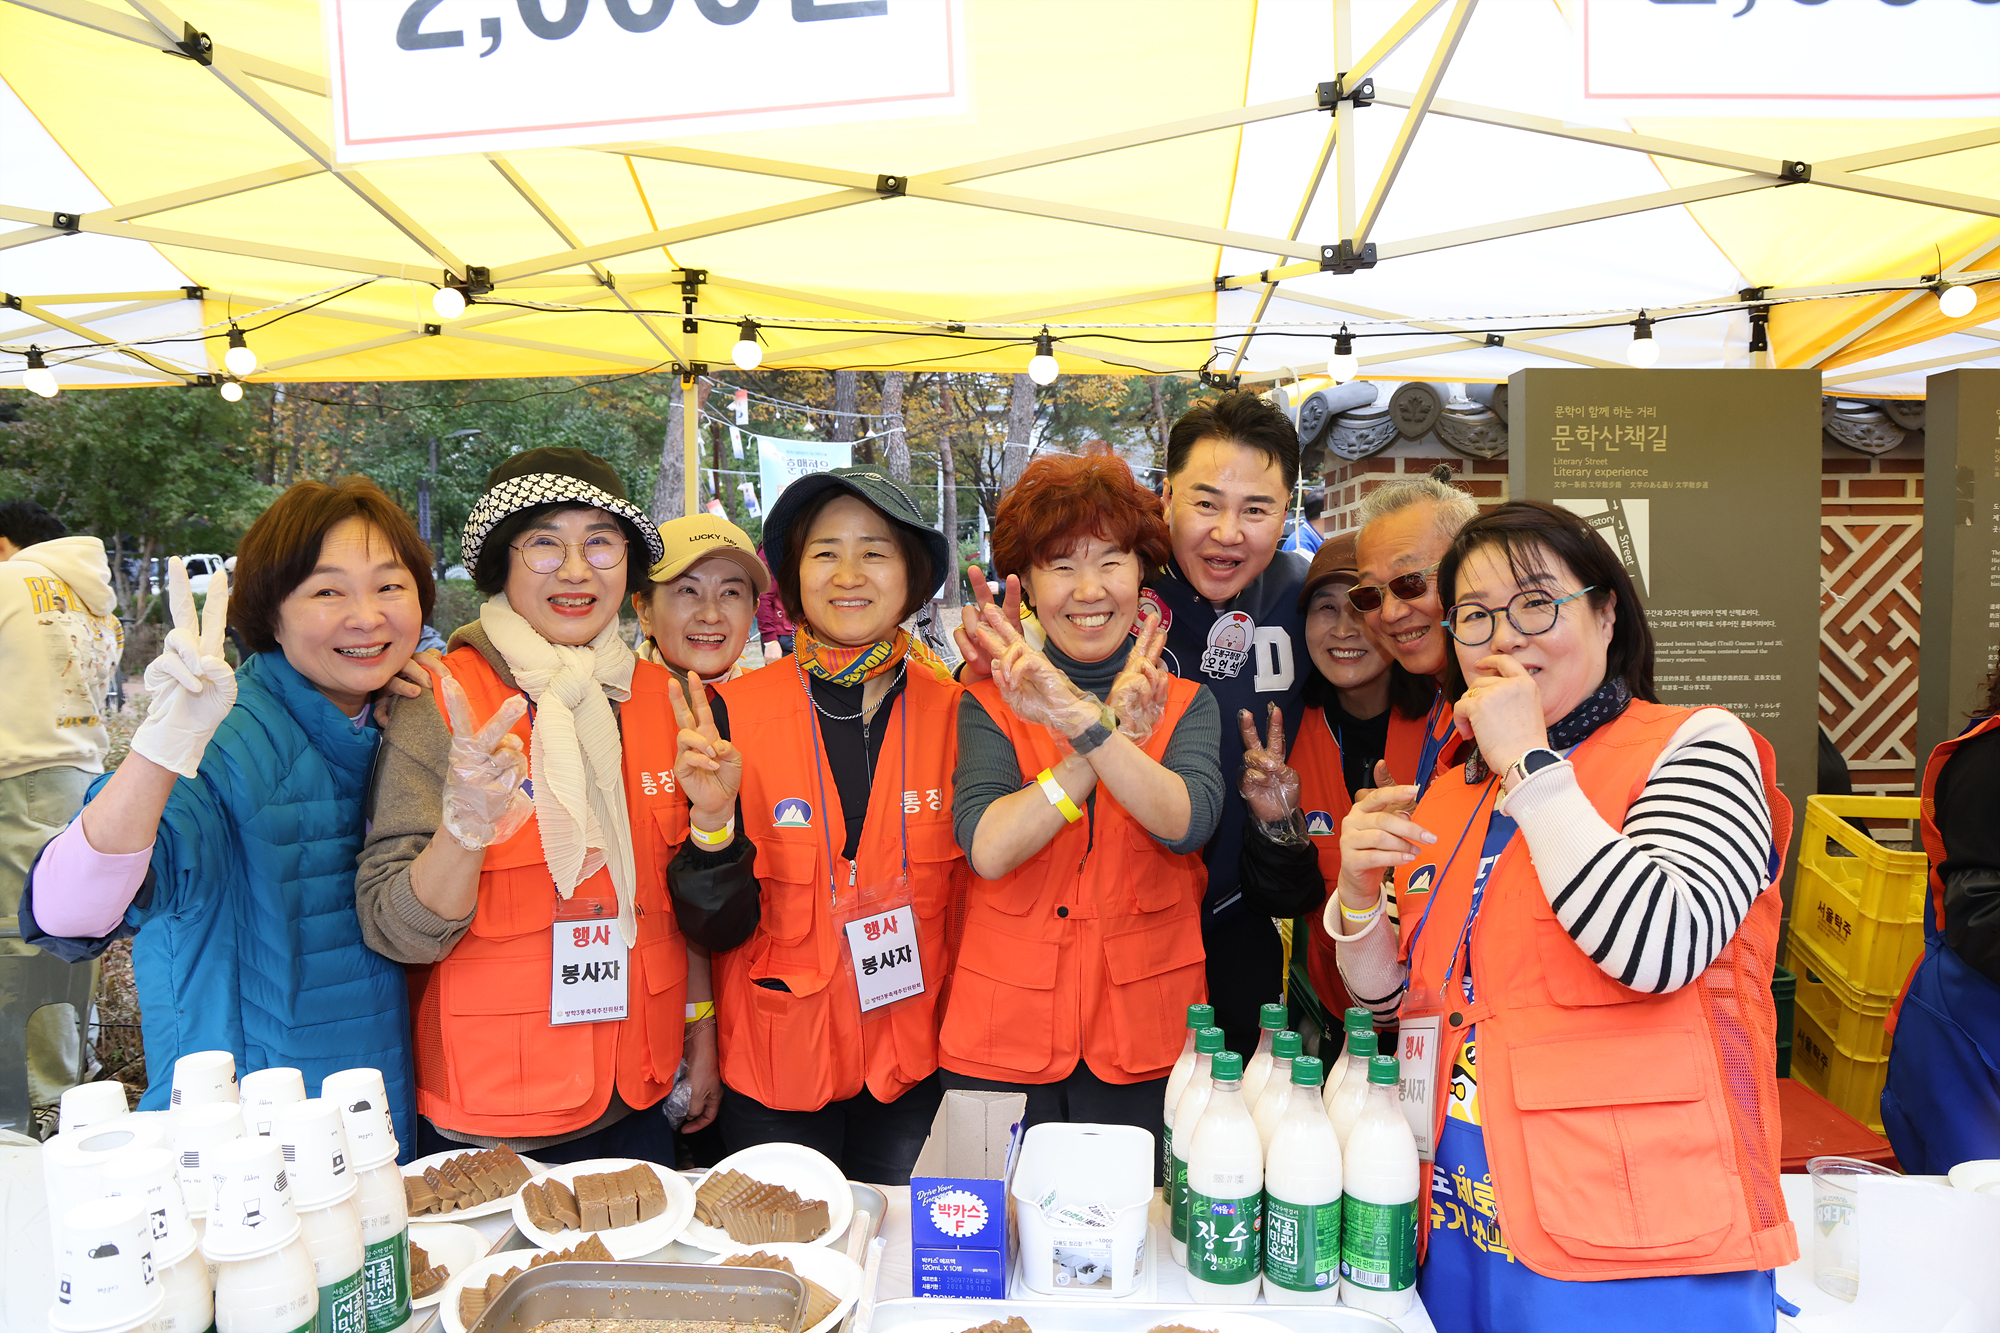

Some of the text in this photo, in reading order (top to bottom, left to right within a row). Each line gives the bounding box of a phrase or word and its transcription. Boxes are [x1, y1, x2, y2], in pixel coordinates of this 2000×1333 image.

[1554, 406, 1657, 418] 문학이 함께 하는 거리
[1551, 424, 1667, 452] 문학산책길
[1553, 457, 1582, 466] Literary
[1553, 467, 1648, 478] Literary experience
[689, 534, 721, 542] LUCKY
[1620, 534, 1635, 566] Street
[1644, 609, 1663, 617] 구간과
[1254, 626, 1295, 692] D
[640, 769, 675, 795] 통장
[900, 788, 942, 814] 통장
[864, 915, 898, 941] 행사
[1817, 900, 1852, 938] 서울탁주
[572, 925, 610, 948] 행사
[862, 944, 912, 976] 봉사자
[562, 960, 620, 985] 봉사자
[565, 1005, 624, 1017] 방학3동축제추진위원회
[1406, 1036, 1424, 1060] 행사
[1398, 1078, 1425, 1104] 봉사자
[917, 1190, 938, 1200] Drive
[938, 1204, 981, 1218] 박카스
[1214, 1205, 1230, 1214] 서울
[956, 1220, 965, 1232] F
[1270, 1218, 1293, 1236] 서울
[1196, 1220, 1249, 1252] 장수
[1270, 1229, 1293, 1247] 미래
[1270, 1242, 1293, 1260] 유산
[1204, 1252, 1246, 1270] 생막걸리
[365, 1262, 390, 1279] 서울
